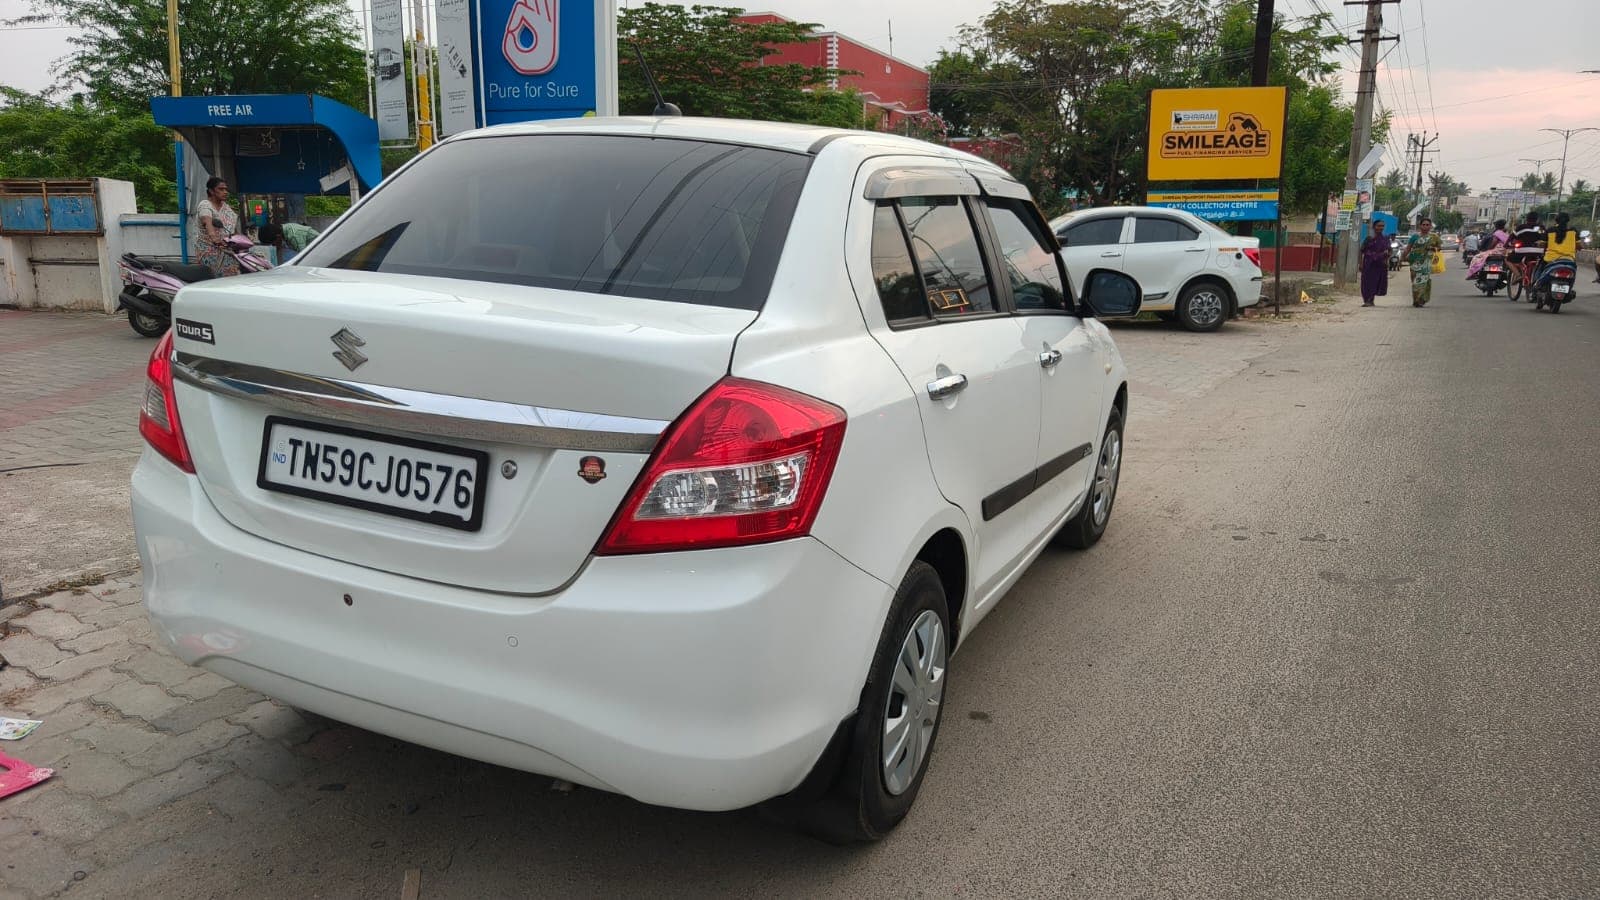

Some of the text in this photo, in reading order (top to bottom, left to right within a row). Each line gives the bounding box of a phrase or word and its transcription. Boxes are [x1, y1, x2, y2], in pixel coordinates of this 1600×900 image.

[489, 82, 579, 98] Pure for Sure
[208, 104, 253, 116] FREE AIR
[1165, 133, 1267, 150] SMILEAGE
[272, 452, 286, 464] IND
[289, 438, 473, 509] TN59CJ0576
